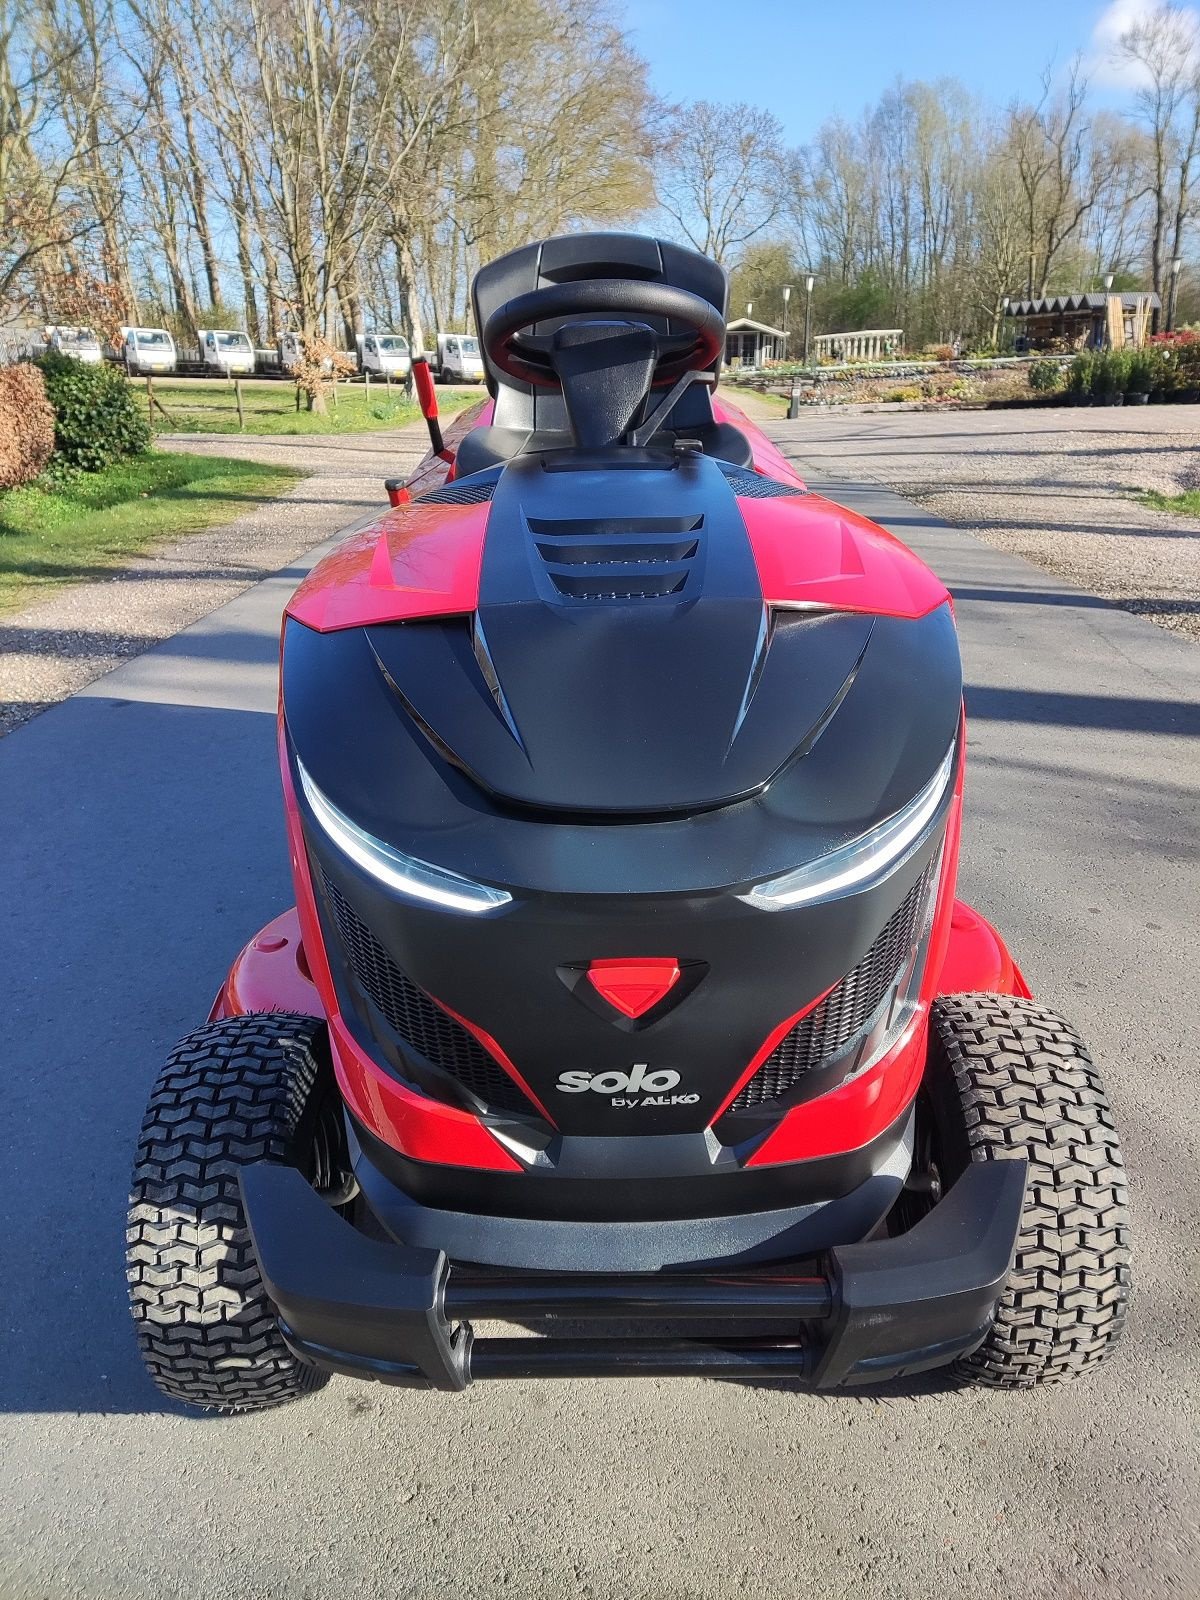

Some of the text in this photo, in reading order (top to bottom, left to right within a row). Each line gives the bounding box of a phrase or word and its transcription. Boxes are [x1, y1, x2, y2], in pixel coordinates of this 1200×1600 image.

[556, 1064, 681, 1094] solo
[611, 1093, 700, 1108] by AL-KO
